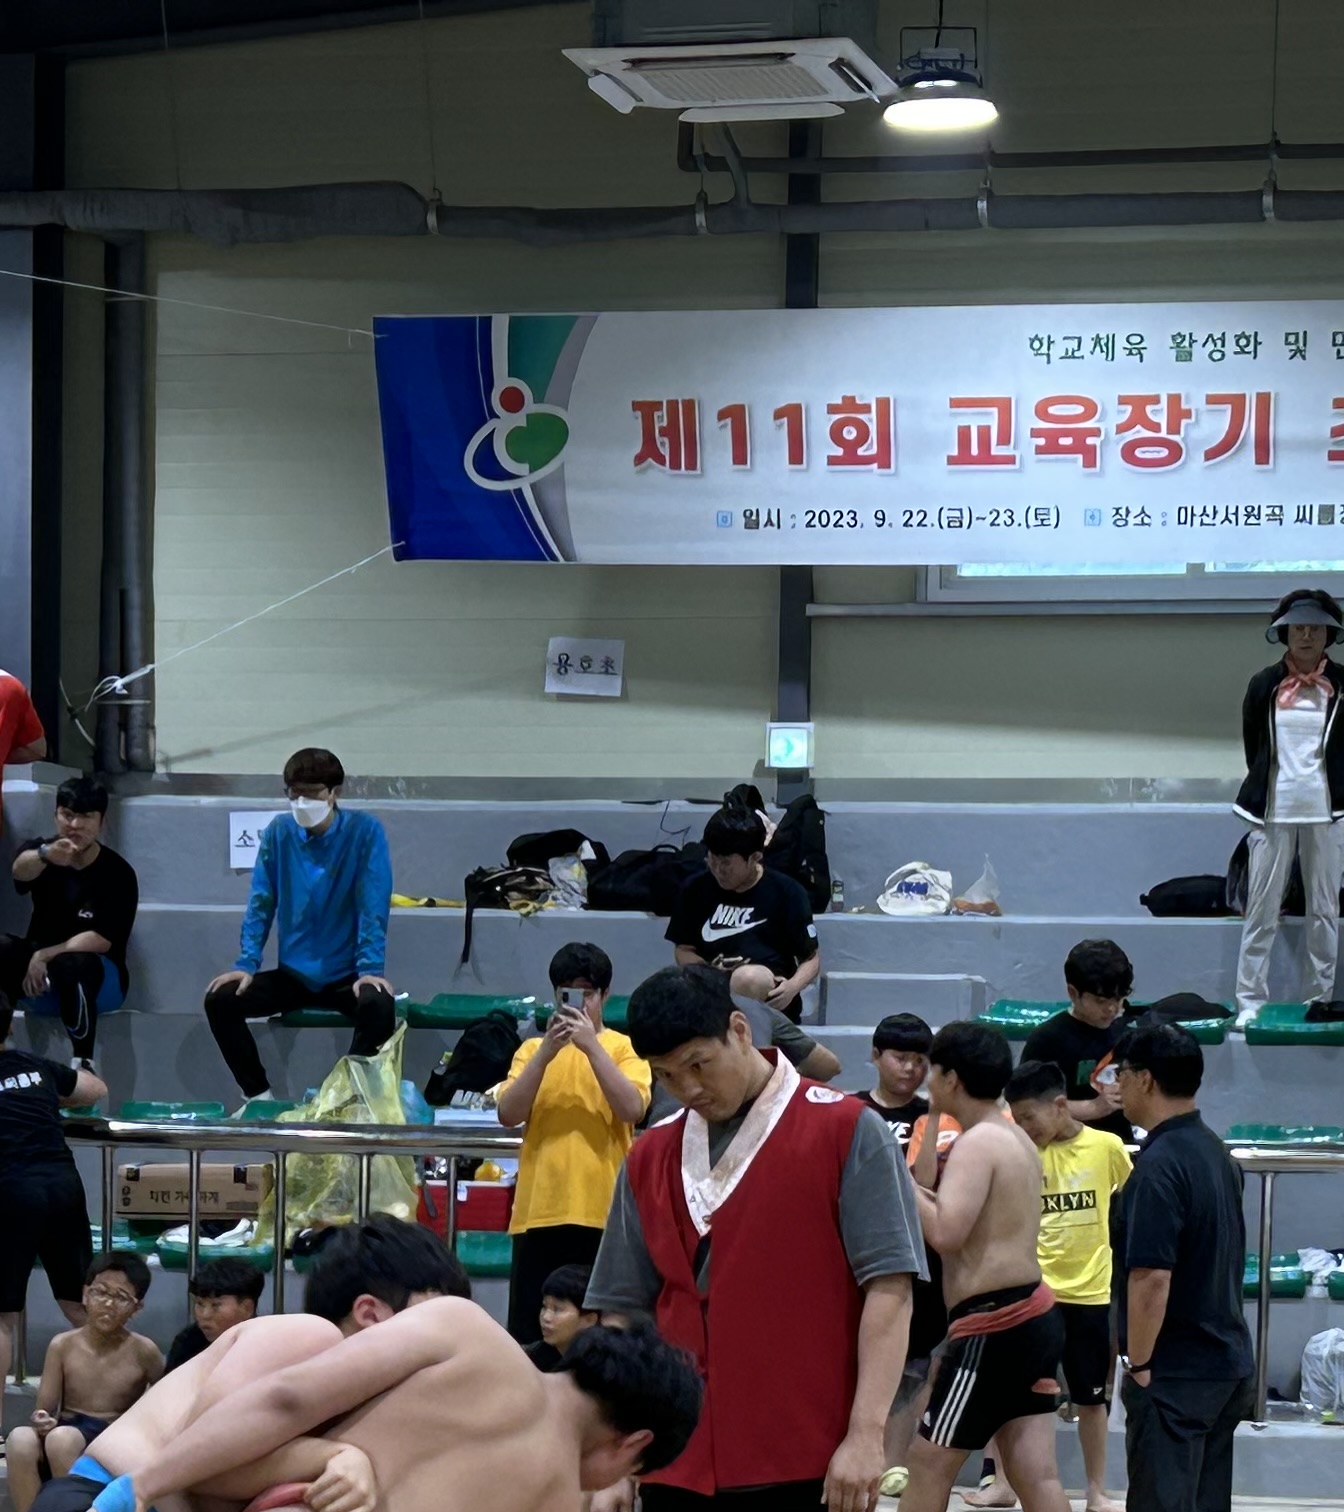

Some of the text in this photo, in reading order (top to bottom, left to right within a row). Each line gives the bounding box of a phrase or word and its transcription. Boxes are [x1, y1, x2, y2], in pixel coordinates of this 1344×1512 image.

[1029, 332, 1148, 365] 학교체육
[1169, 331, 1263, 362] 활성화
[1284, 330, 1308, 360] 및
[630, 394, 894, 472] 제11회
[946, 391, 1273, 469] 교육장기
[1111, 505, 1152, 528] 장소
[1177, 504, 1285, 528] 마산서원곡
[710, 903, 755, 926] NIKE
[1042, 1191, 1094, 1212] KLYN
